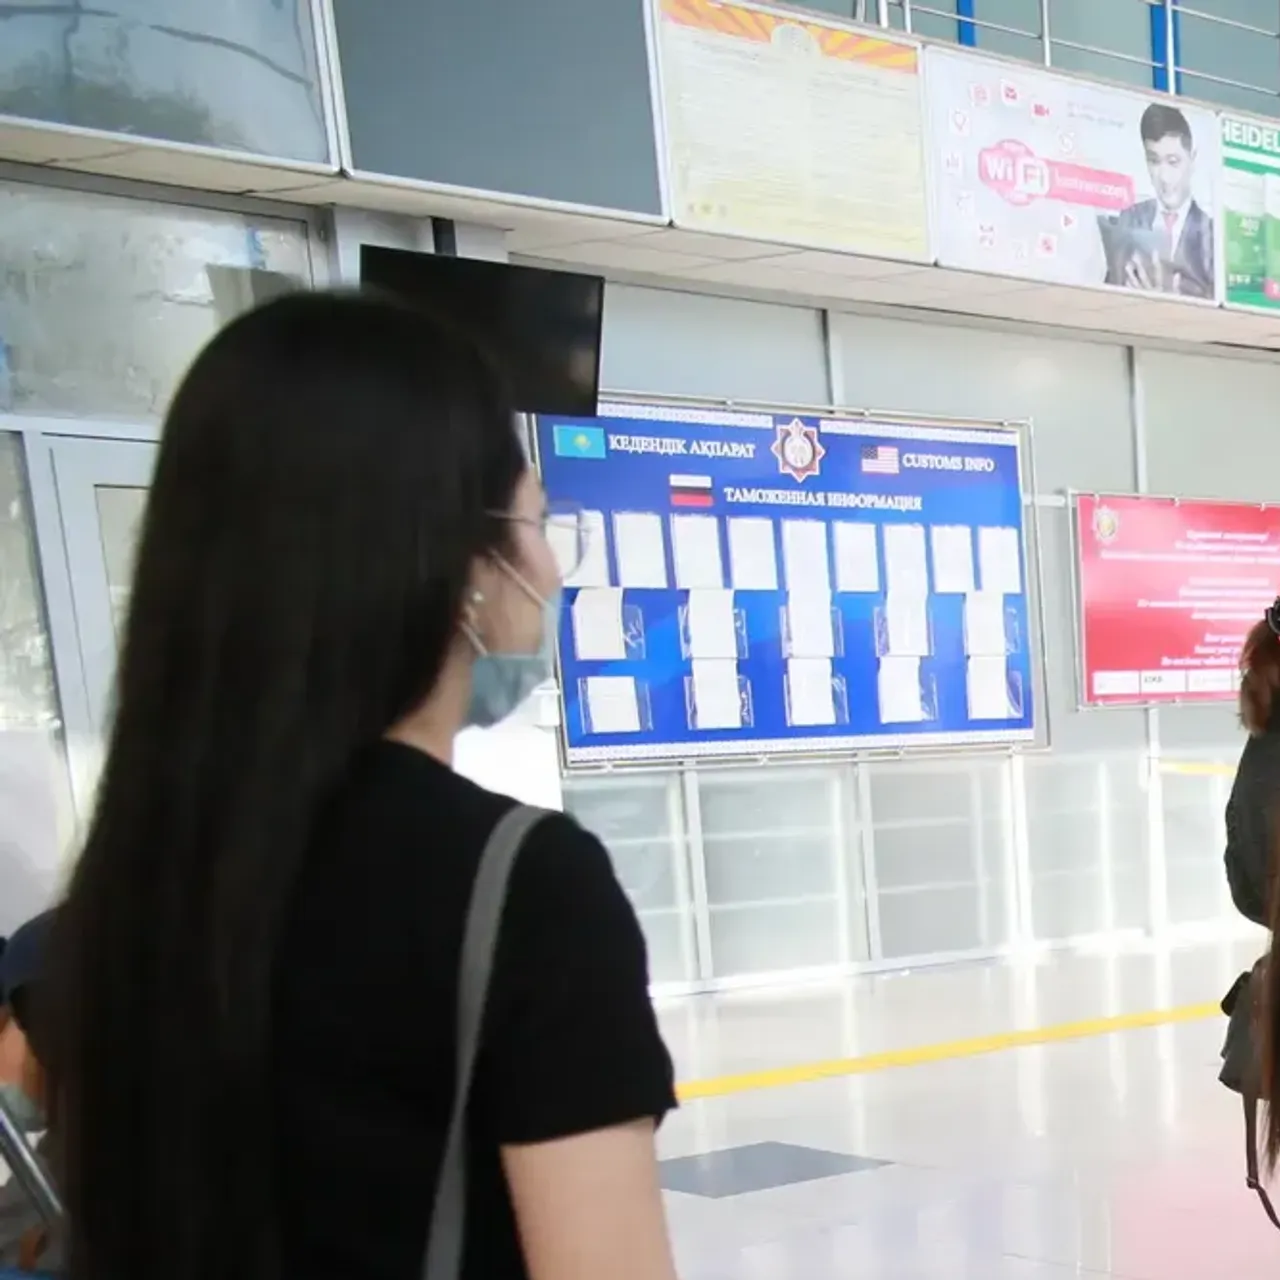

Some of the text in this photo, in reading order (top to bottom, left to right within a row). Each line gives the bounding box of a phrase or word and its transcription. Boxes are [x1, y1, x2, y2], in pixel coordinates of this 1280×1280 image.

[902, 453, 995, 473] CUSTOMS INFO
[724, 487, 922, 512] ТАМОЖЕННАЯ ИНФОРМАЦИЯ
